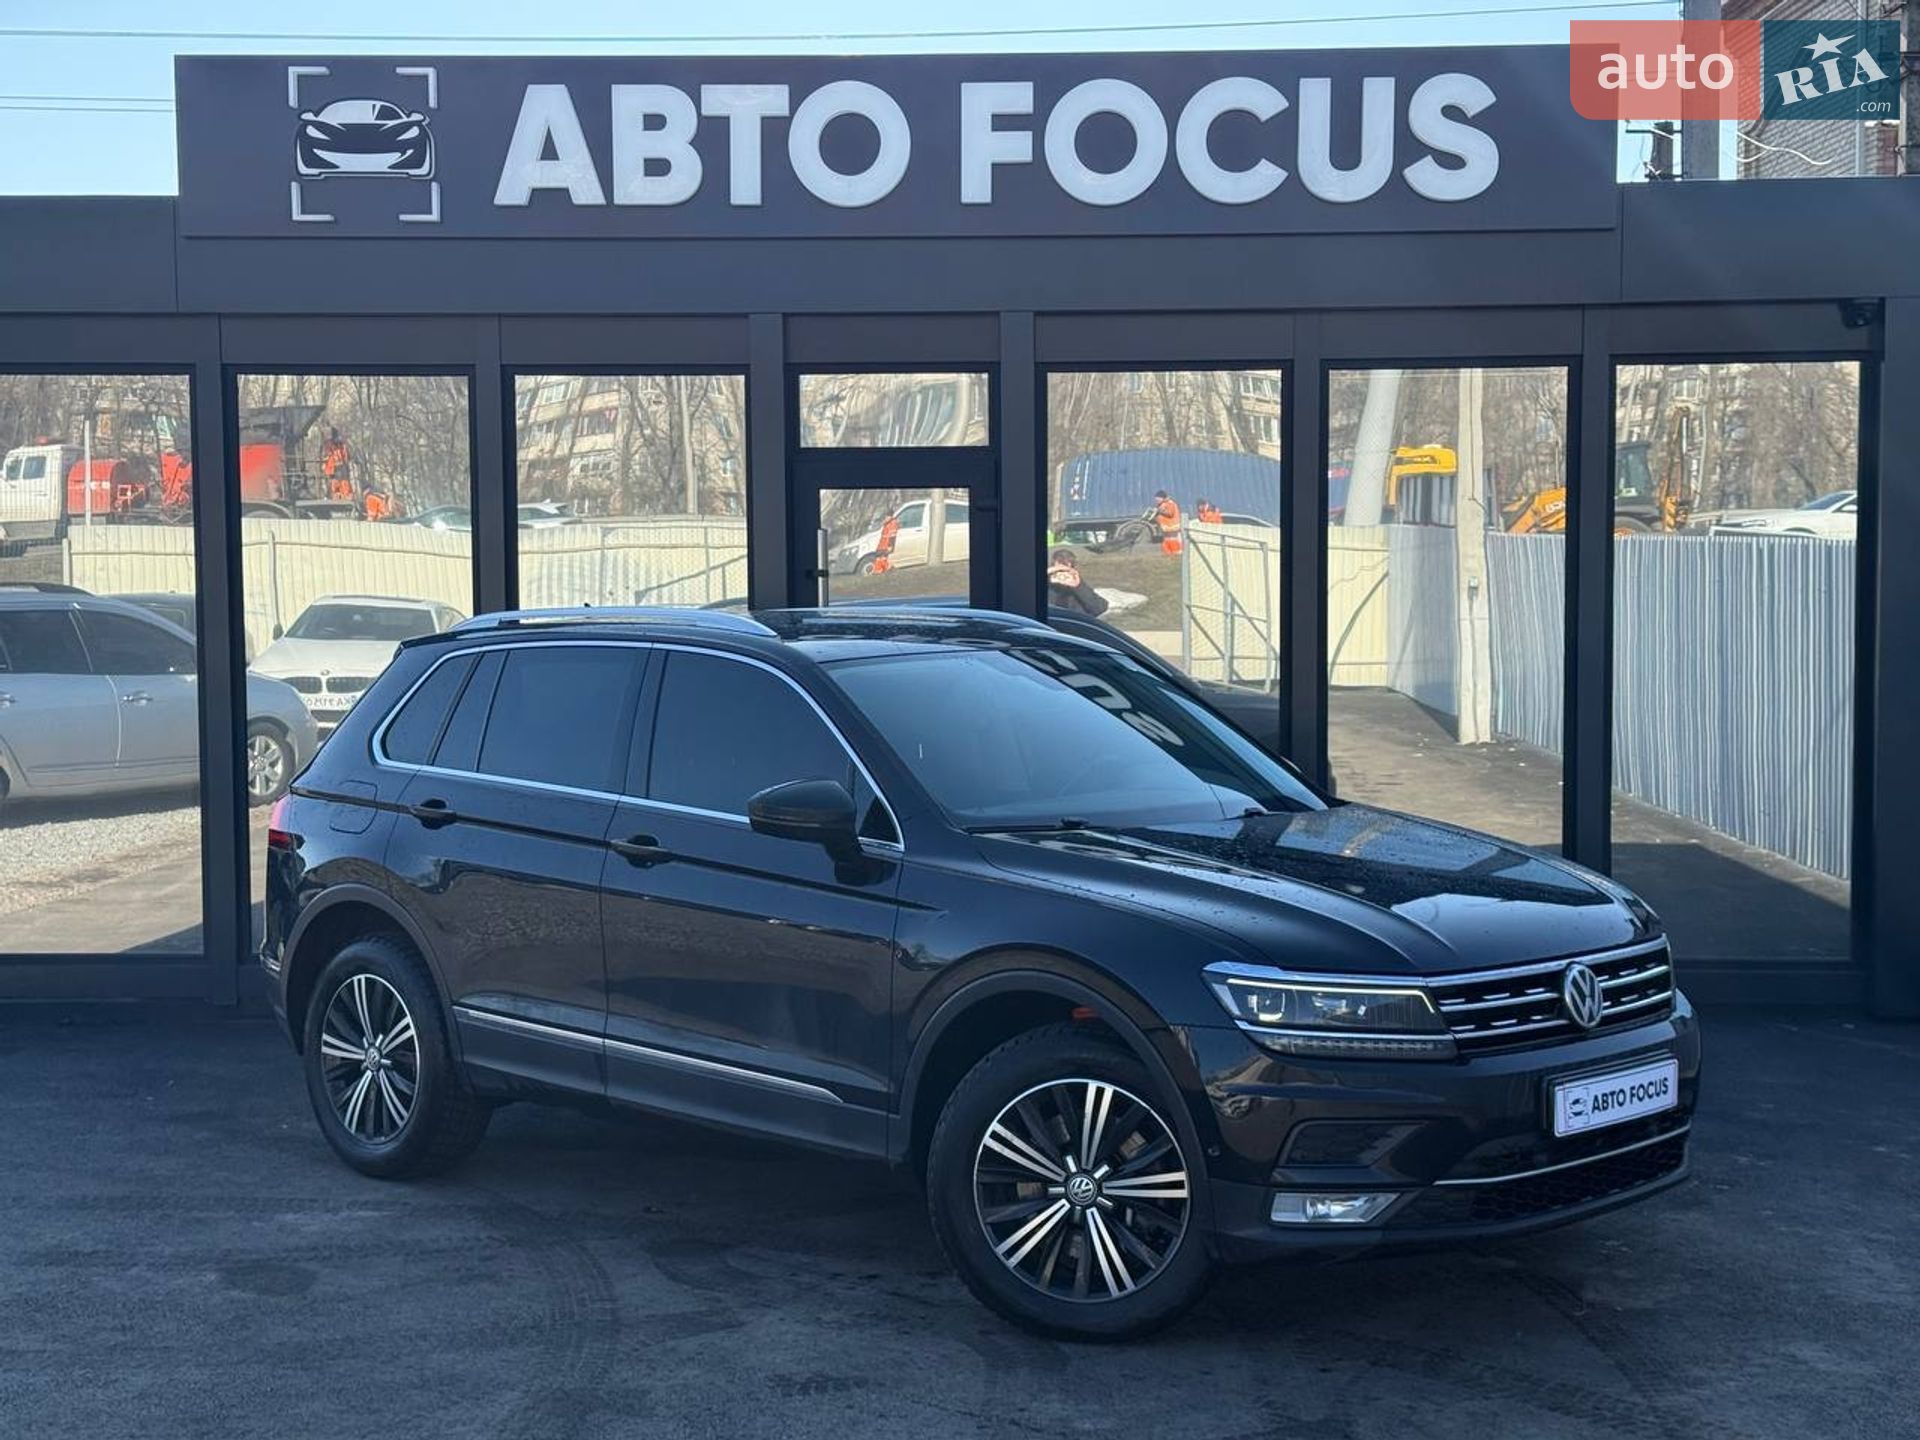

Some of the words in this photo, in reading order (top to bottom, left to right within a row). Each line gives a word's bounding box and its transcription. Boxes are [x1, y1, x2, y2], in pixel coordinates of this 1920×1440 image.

[493, 80, 911, 208] АВТО
[960, 72, 1499, 206] FOCUS
[1591, 1088, 1627, 1115] АВТО
[1629, 1077, 1669, 1105] FOCUS
